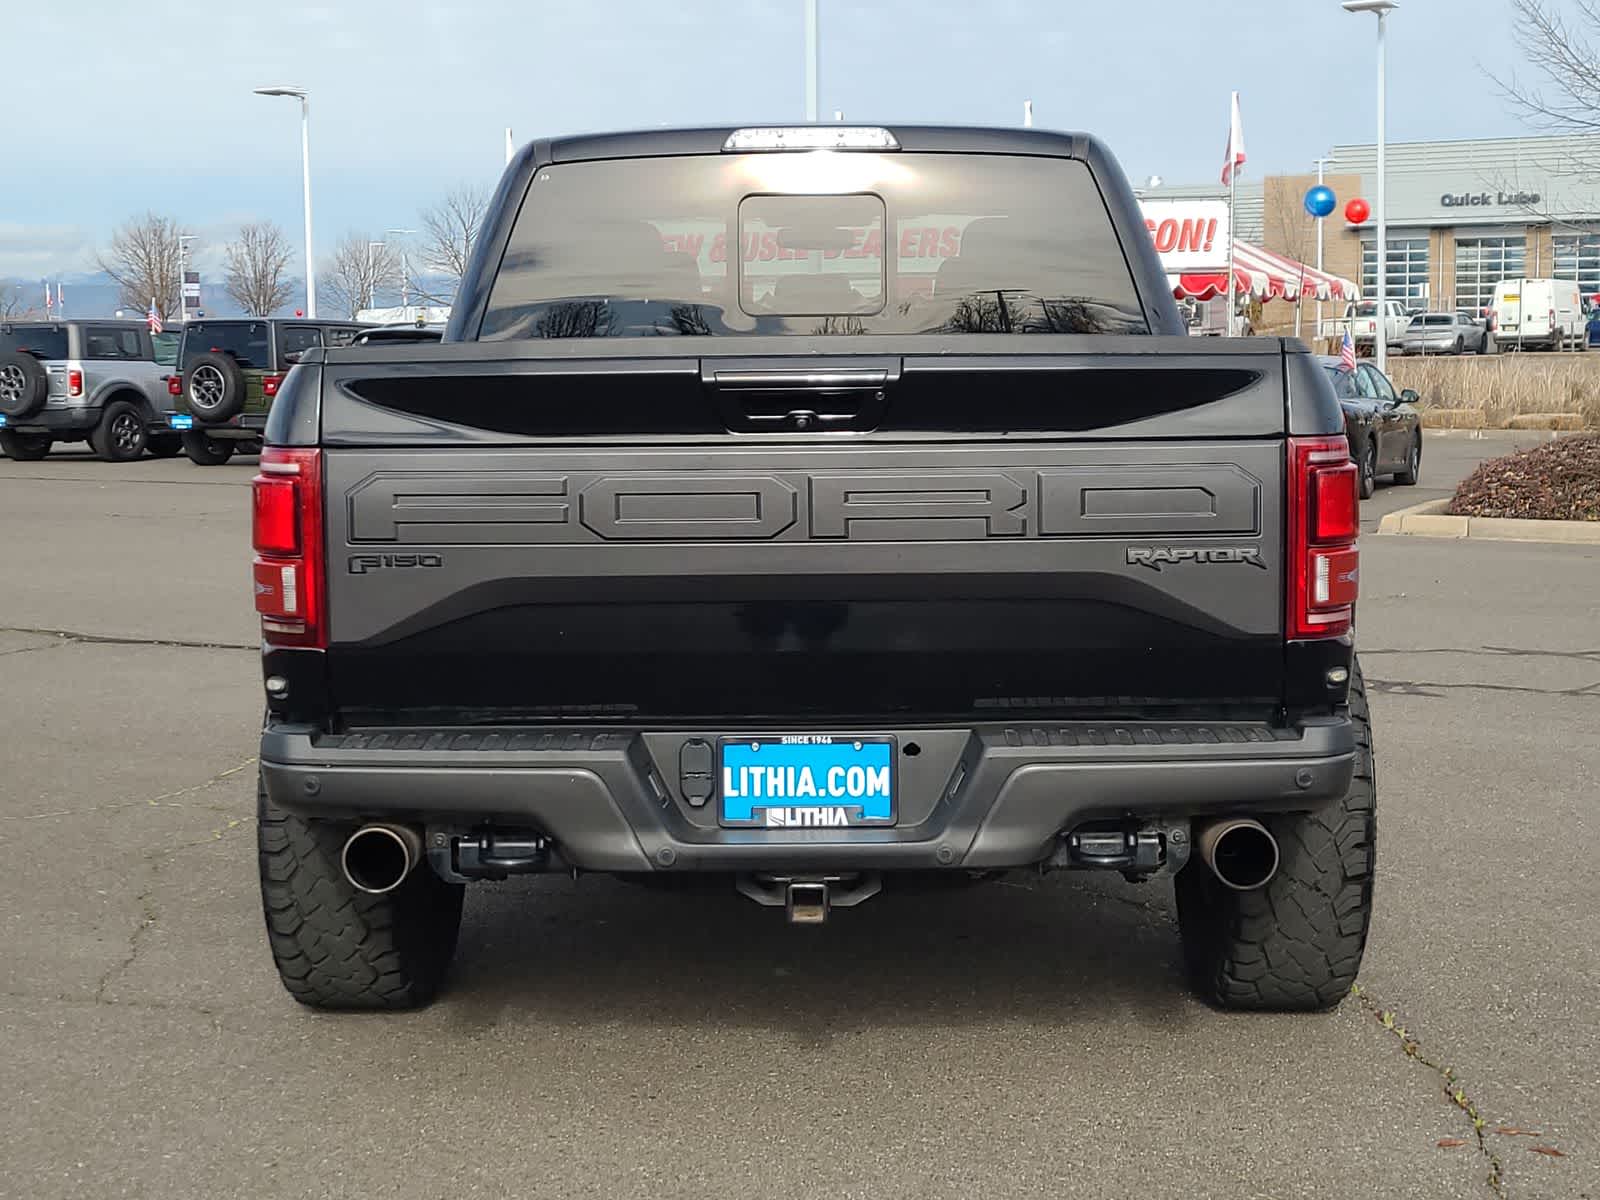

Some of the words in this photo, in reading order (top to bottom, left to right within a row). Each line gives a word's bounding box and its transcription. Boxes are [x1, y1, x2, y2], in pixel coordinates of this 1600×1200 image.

[1441, 193, 1492, 207] Quick
[1497, 191, 1541, 206] Lube
[656, 231, 705, 258] EW
[345, 463, 1263, 542] FORD
[1126, 546, 1267, 571] RAPTOR
[781, 736, 809, 745] SINCE
[811, 736, 833, 745] 1946
[722, 766, 890, 798] LITHIA.COM
[785, 807, 849, 826] LITHIA
